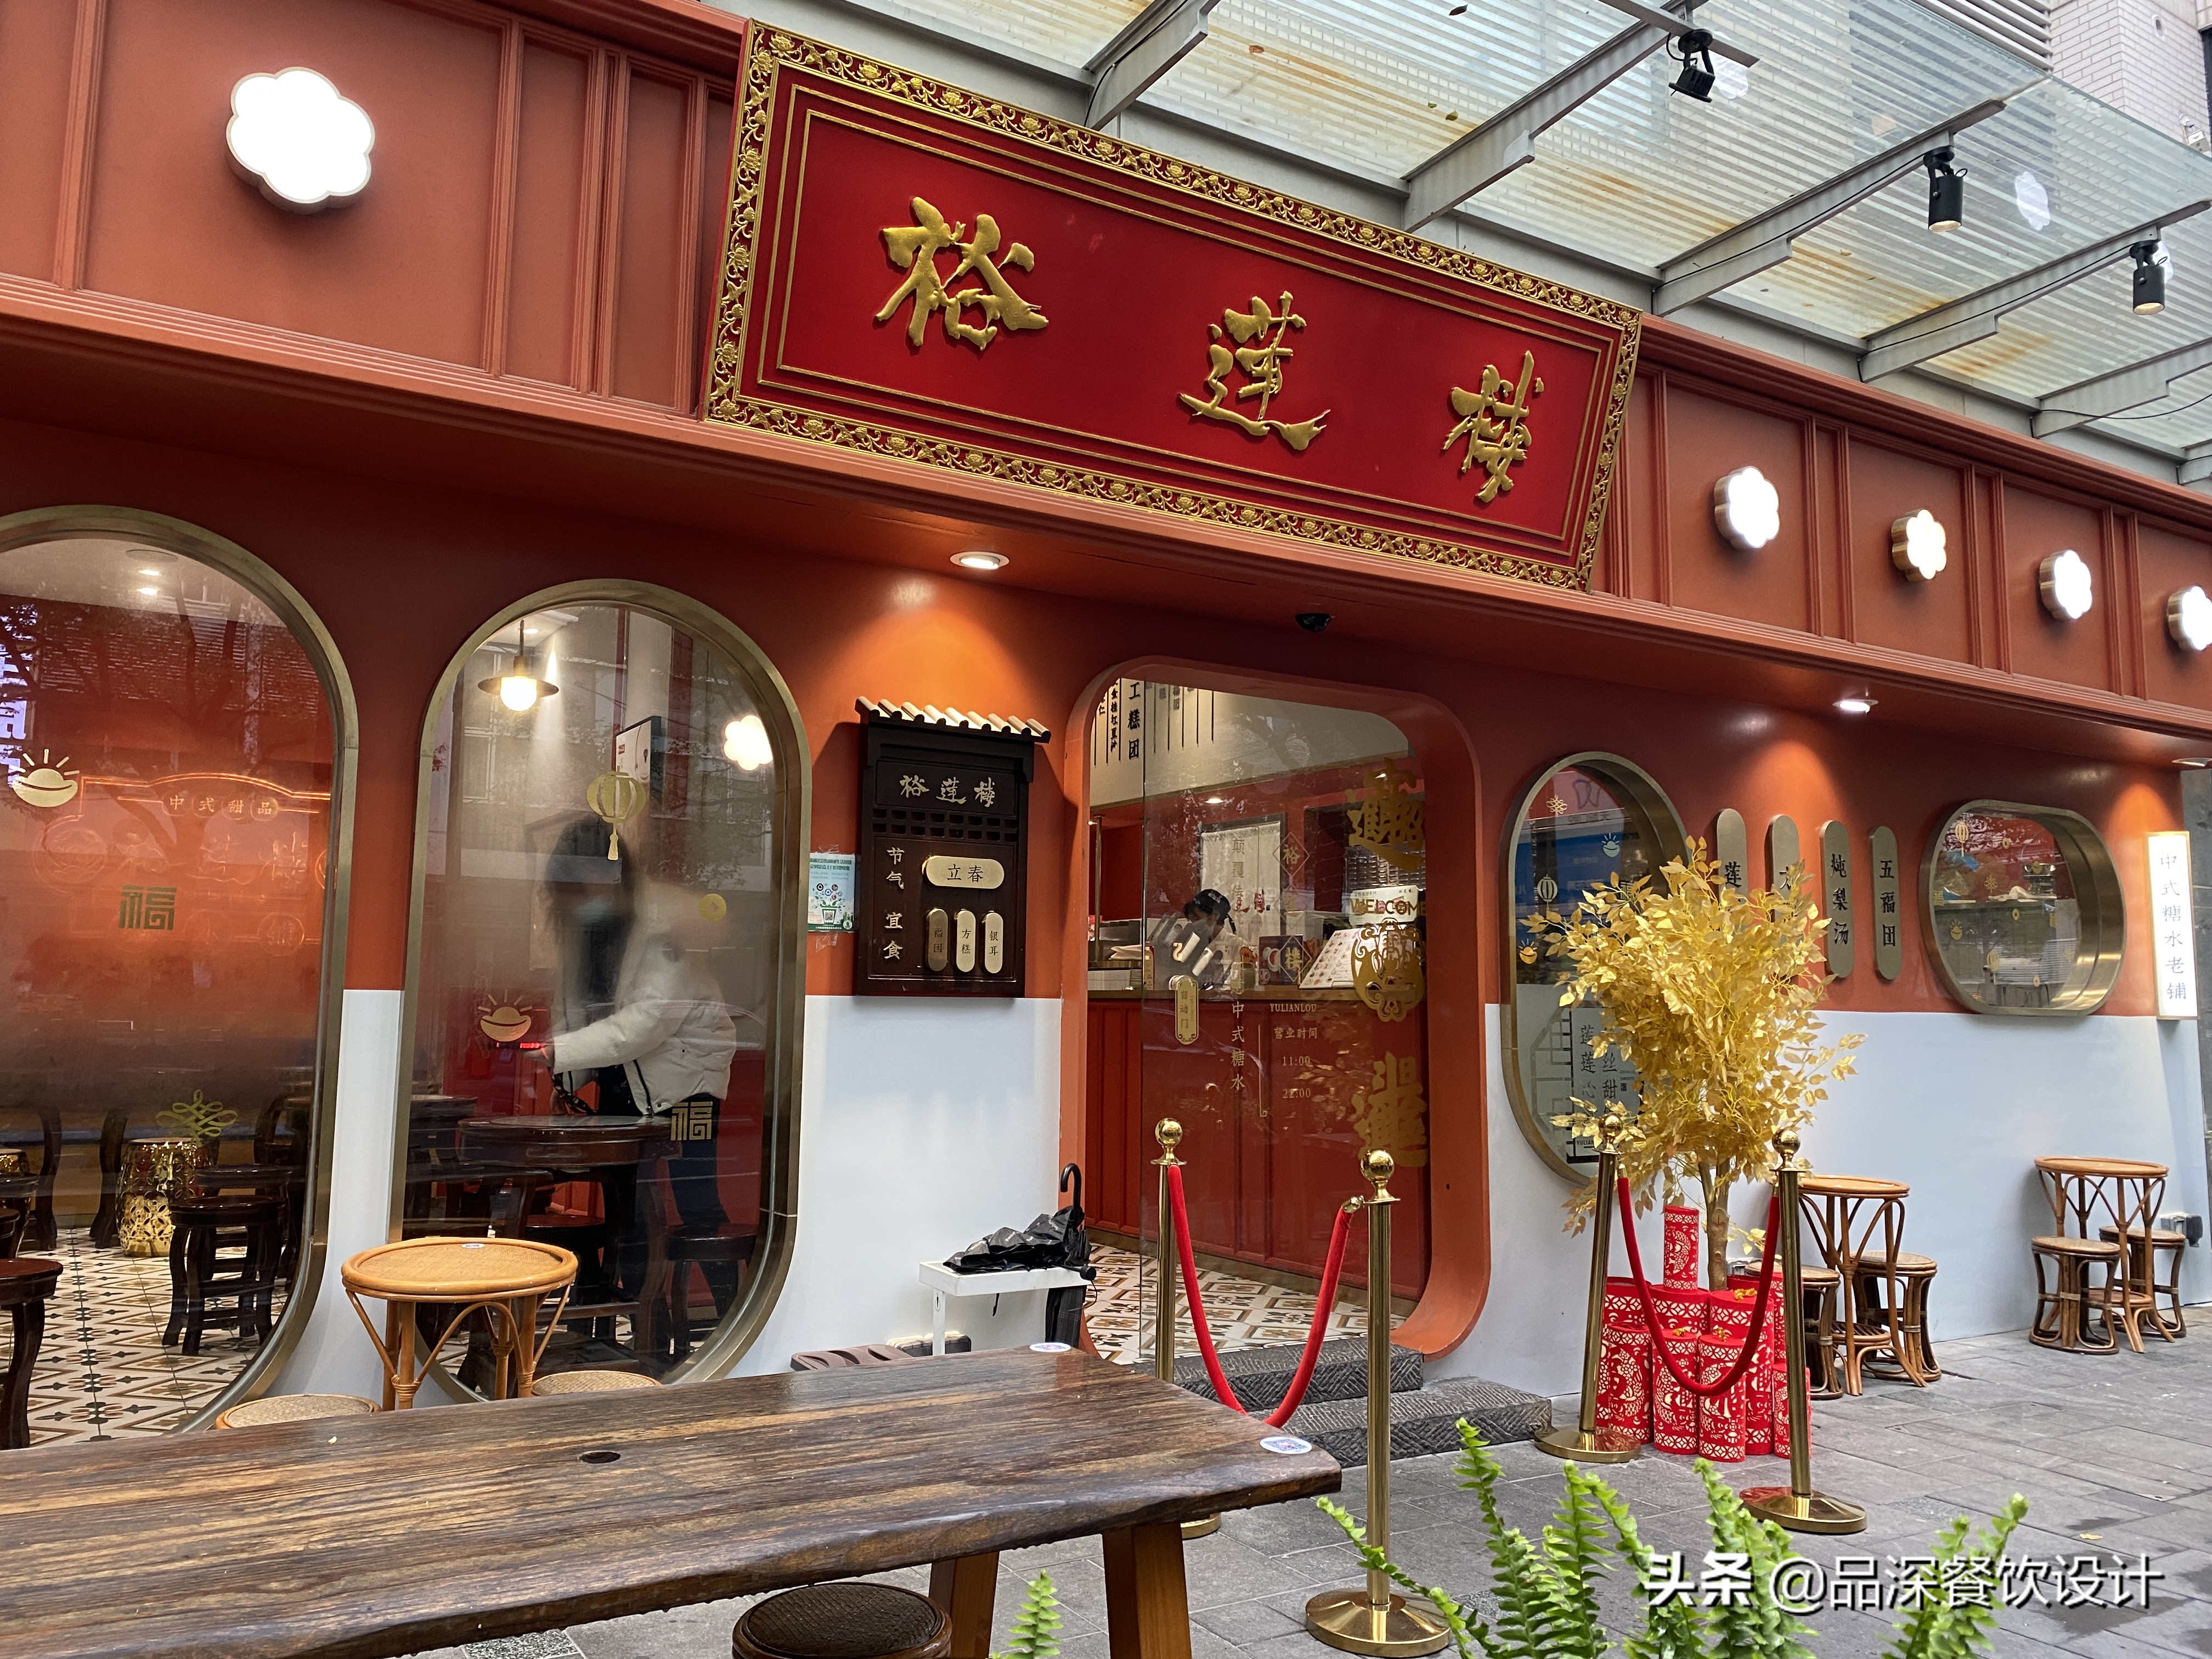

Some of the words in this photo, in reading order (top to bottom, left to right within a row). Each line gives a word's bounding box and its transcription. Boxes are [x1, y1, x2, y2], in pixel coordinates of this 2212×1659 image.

[1110, 682, 1119, 753] 金桂红豆沙
[169, 795, 273, 816] 中式甜品
[946, 864, 984, 883] 立春
[884, 847, 905, 961] 节气宜食
[1830, 853, 1849, 945] 炖梨汤
[1879, 860, 1896, 947] 五福团
[933, 927, 943, 953] 福团
[2160, 853, 2187, 1001] 中式糖水老铺
[961, 929, 971, 954] 方糕
[989, 930, 999, 956] 银耳
[1179, 990, 1188, 1029] 自动门
[1269, 1003, 1317, 1013] YULIANLOU
[1274, 1026, 1318, 1040] 营业时间
[1283, 1056, 1311, 1066] 11:00
[1580, 1024, 1597, 1117] 莲莲心
